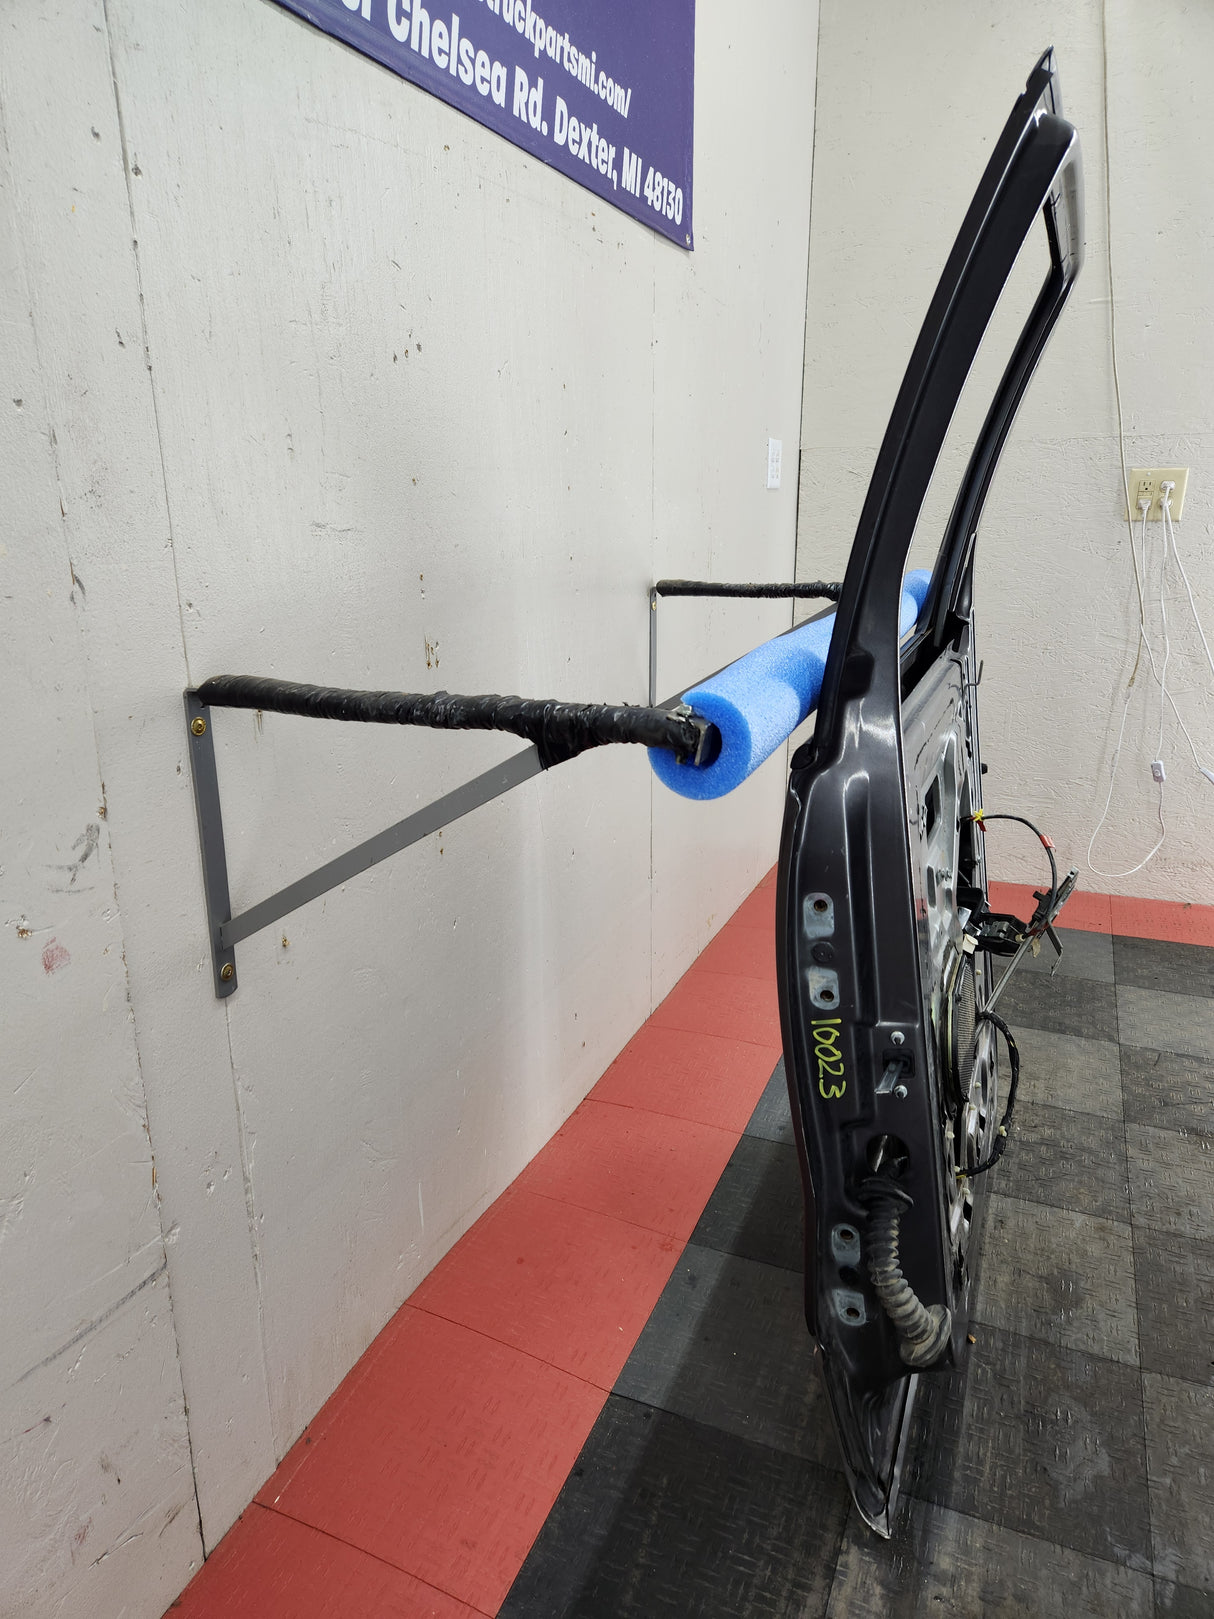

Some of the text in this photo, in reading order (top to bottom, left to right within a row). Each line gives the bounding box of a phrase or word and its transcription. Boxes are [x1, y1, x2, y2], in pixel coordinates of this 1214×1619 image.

[387, 0, 683, 225] Chelsea Rd. Dexter, MI 48130
